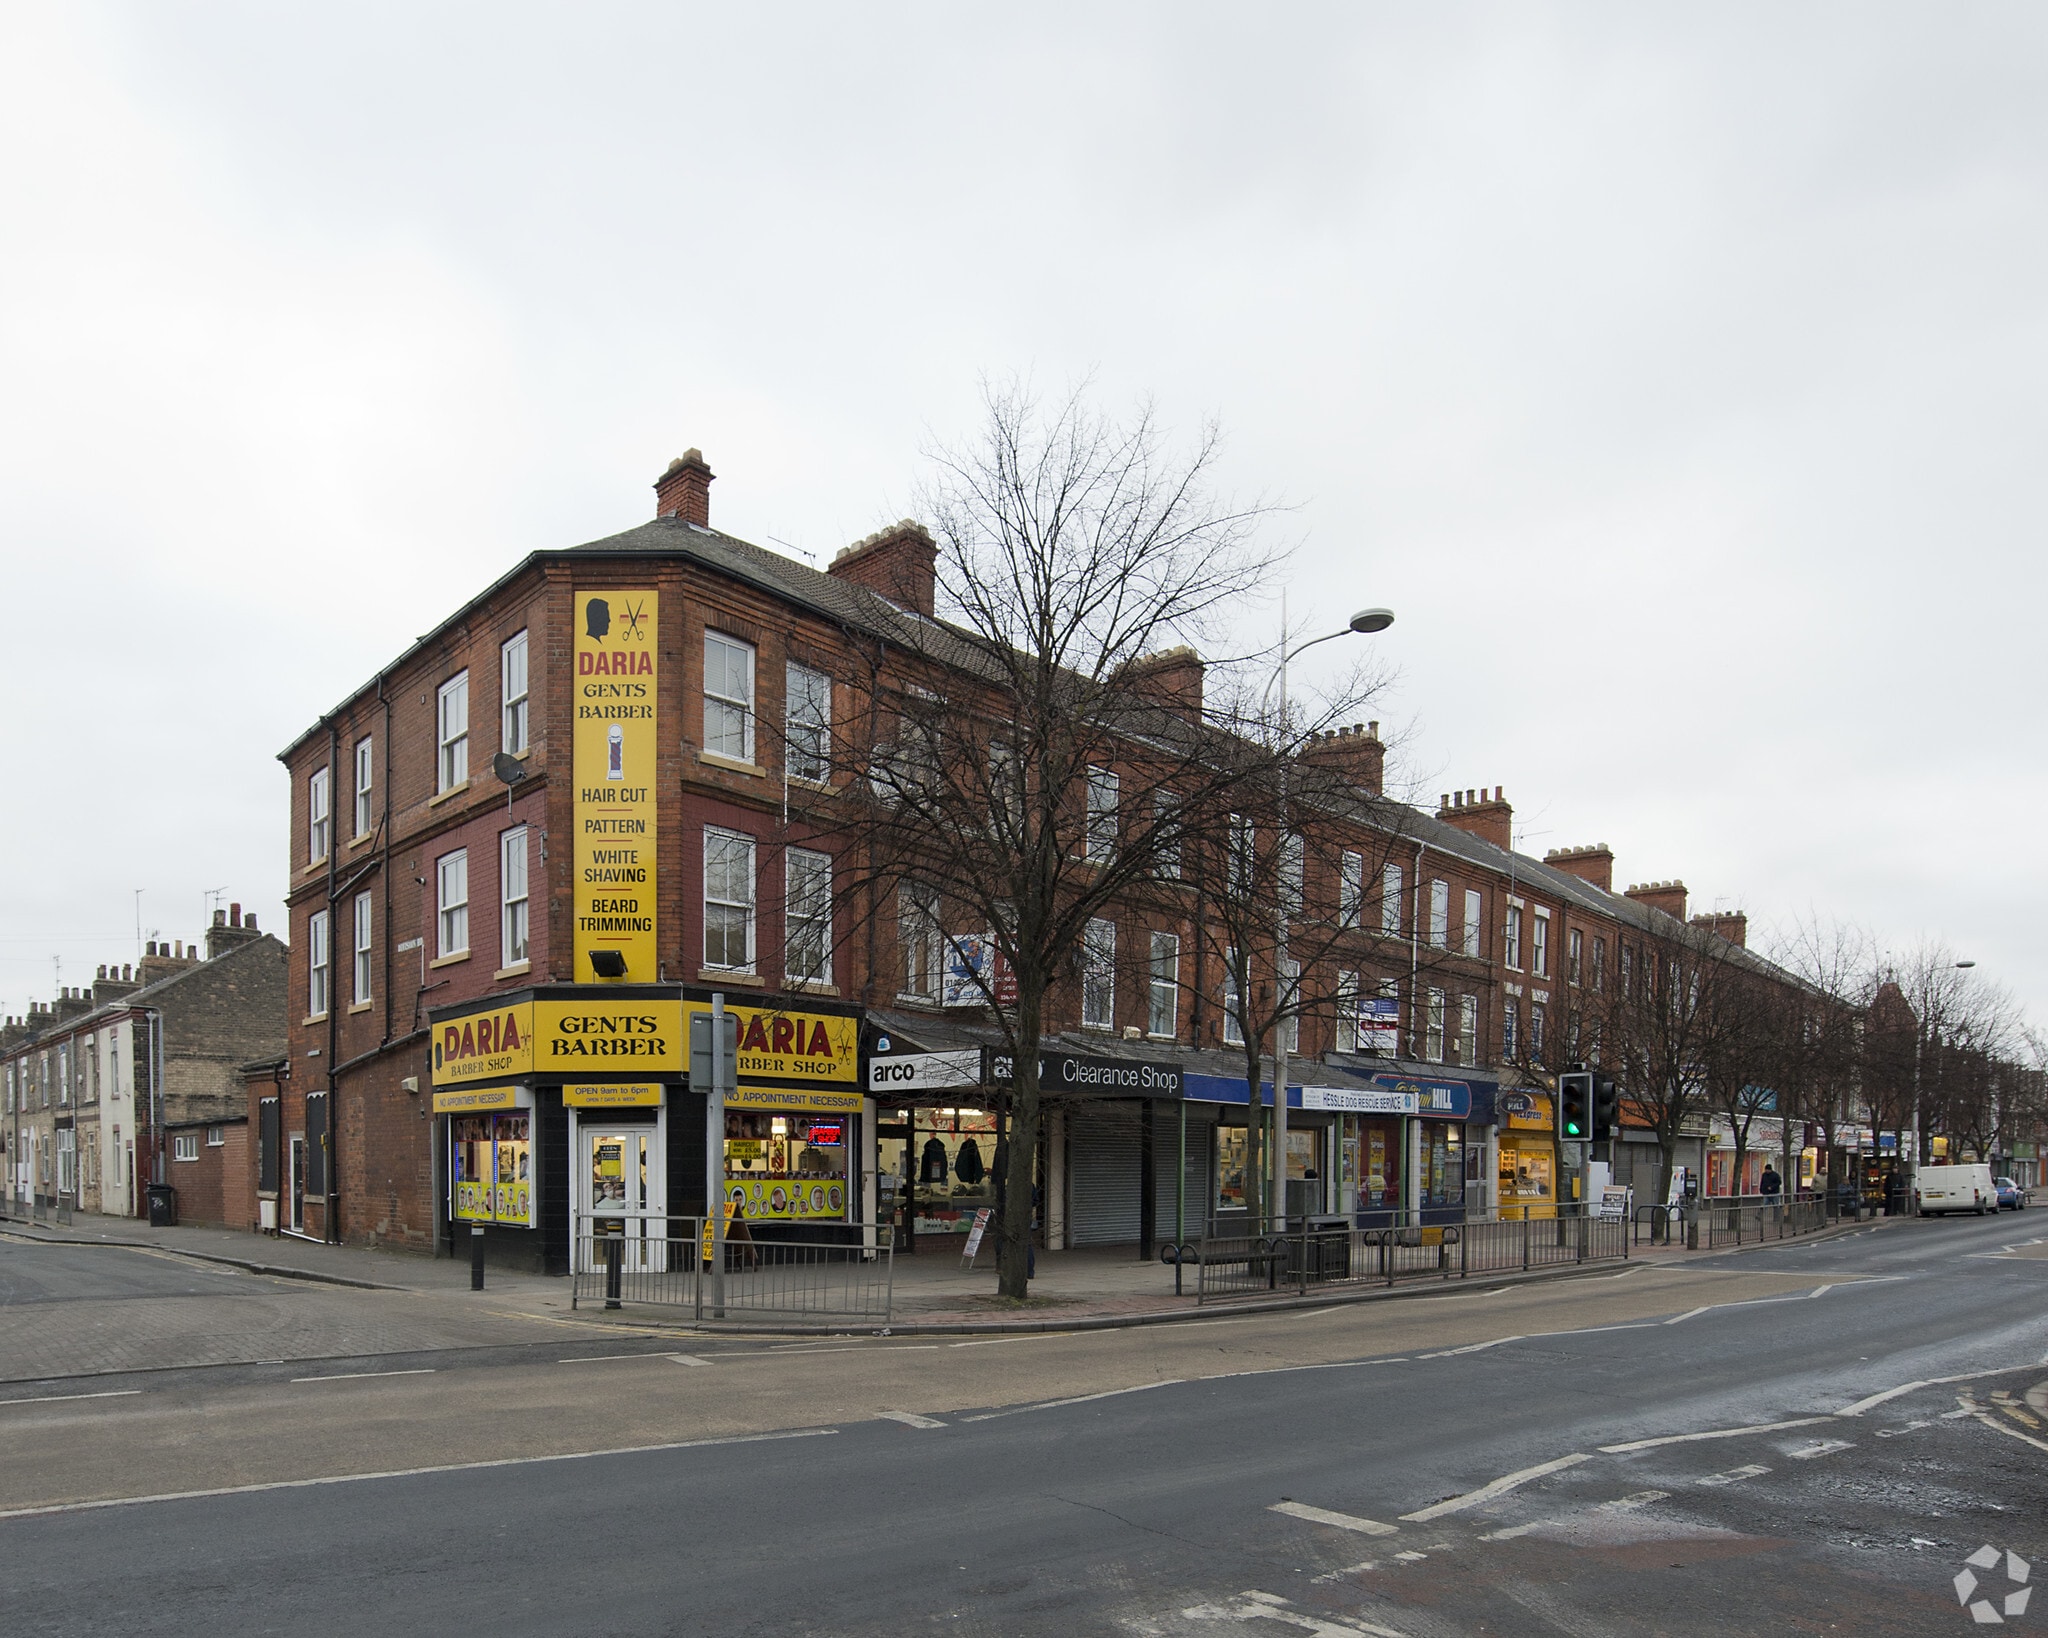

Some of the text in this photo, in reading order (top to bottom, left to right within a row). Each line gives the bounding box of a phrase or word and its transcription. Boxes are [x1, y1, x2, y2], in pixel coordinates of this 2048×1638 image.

[578, 651, 653, 676] DARIA
[583, 683, 647, 698] GENTS
[578, 705, 653, 719] BARBER
[581, 788, 648, 803] HAIR CUT
[584, 820, 645, 834] PATTERN
[592, 850, 638, 864] WHITE
[584, 868, 646, 883] SHAVING
[591, 899, 639, 913] BEARD
[578, 917, 652, 932] TRIMMING
[559, 1015, 658, 1034] GENTS
[444, 1013, 521, 1062] DARIA
[551, 1037, 666, 1056] BARBER
[451, 1056, 512, 1077] BARBER SHOP
[739, 1056, 837, 1075] RBER SHOP
[873, 1063, 915, 1082] arco
[1062, 1059, 1178, 1093] Clearance Shop
[575, 1087, 598, 1095] OPEN
[600, 1087, 618, 1095] 9am
[631, 1086, 649, 1095] 6pm
[447, 1095, 477, 1106] APPOINTMENT
[478, 1093, 507, 1104] NECESSARY
[725, 1092, 859, 1107] NO APPOINTMENT NECESSARY
[1322, 1092, 1345, 1108] HESSLE
[1345, 1096, 1358, 1108] DOG
[1358, 1097, 1379, 1109] RESCUE
[1379, 1096, 1401, 1110] SERVICE
[1432, 1088, 1452, 1109] HILL
[817, 1135, 837, 1143] SHOP
